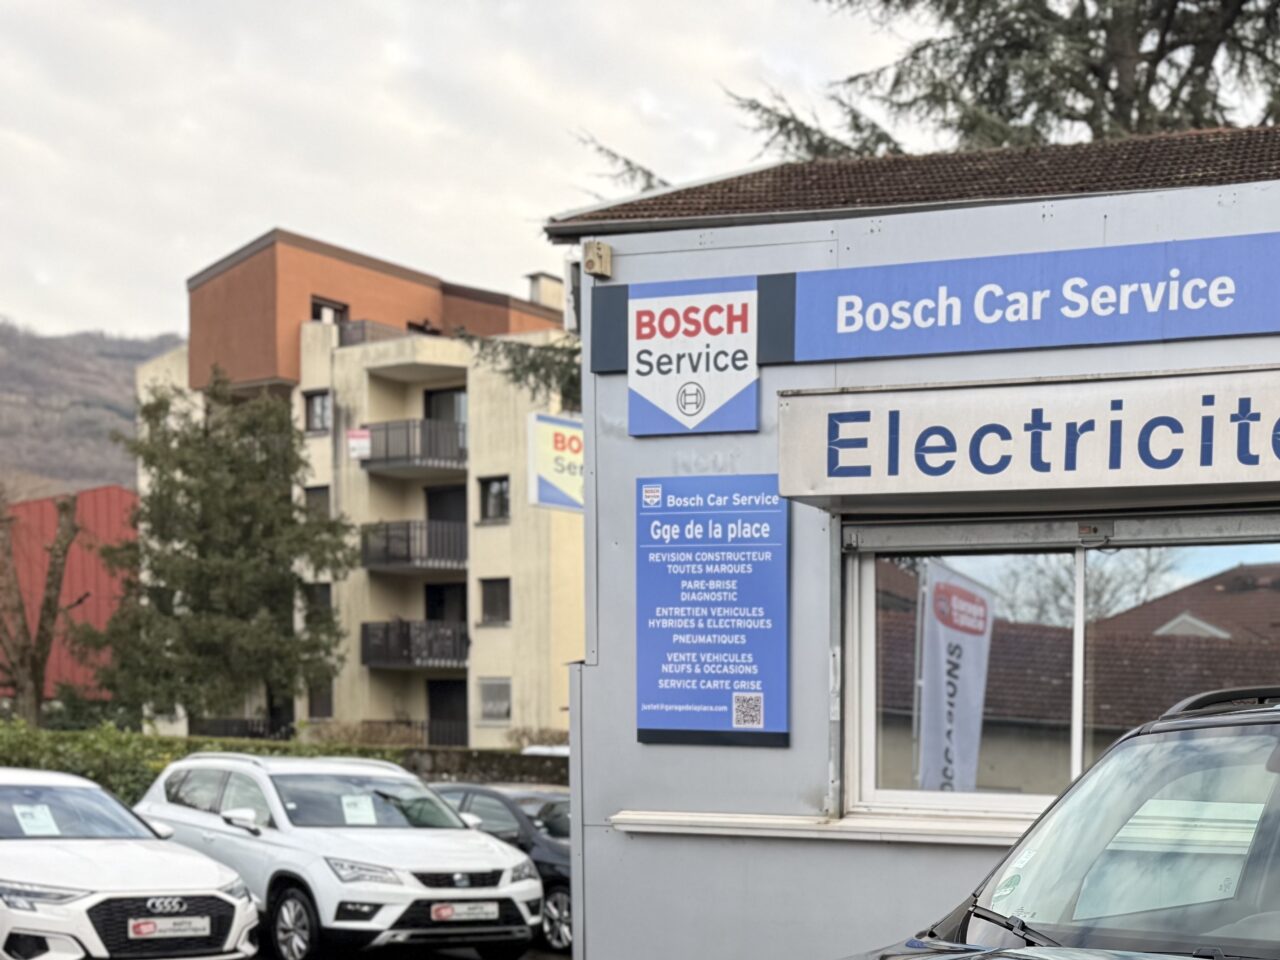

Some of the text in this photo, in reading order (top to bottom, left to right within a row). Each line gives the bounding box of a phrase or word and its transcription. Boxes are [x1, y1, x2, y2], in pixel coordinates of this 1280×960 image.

[836, 268, 1236, 334] Bosch Car Service
[635, 303, 749, 341] BOSCH
[635, 343, 749, 377] Service
[667, 492, 780, 508] Bosch Car Service
[650, 518, 770, 543] Gge de la place
[649, 551, 772, 562] REVISION CONSTRUCTEUR
[667, 564, 753, 574] TOUTES MARQUES
[681, 580, 738, 589] PARE-BRISE
[680, 591, 738, 601] DIAGNOSTIC
[656, 607, 764, 616] ENTRETIEN VEHICULES
[648, 619, 772, 629] HYBRIDES & ELECTRIQUES
[672, 634, 747, 644] PNEUMATIQUES
[666, 652, 753, 663] VENTE VEHICULES
[661, 664, 758, 674] NEUFS & OCCASIONS
[658, 679, 763, 690] SERVICE CARTE GRISE
